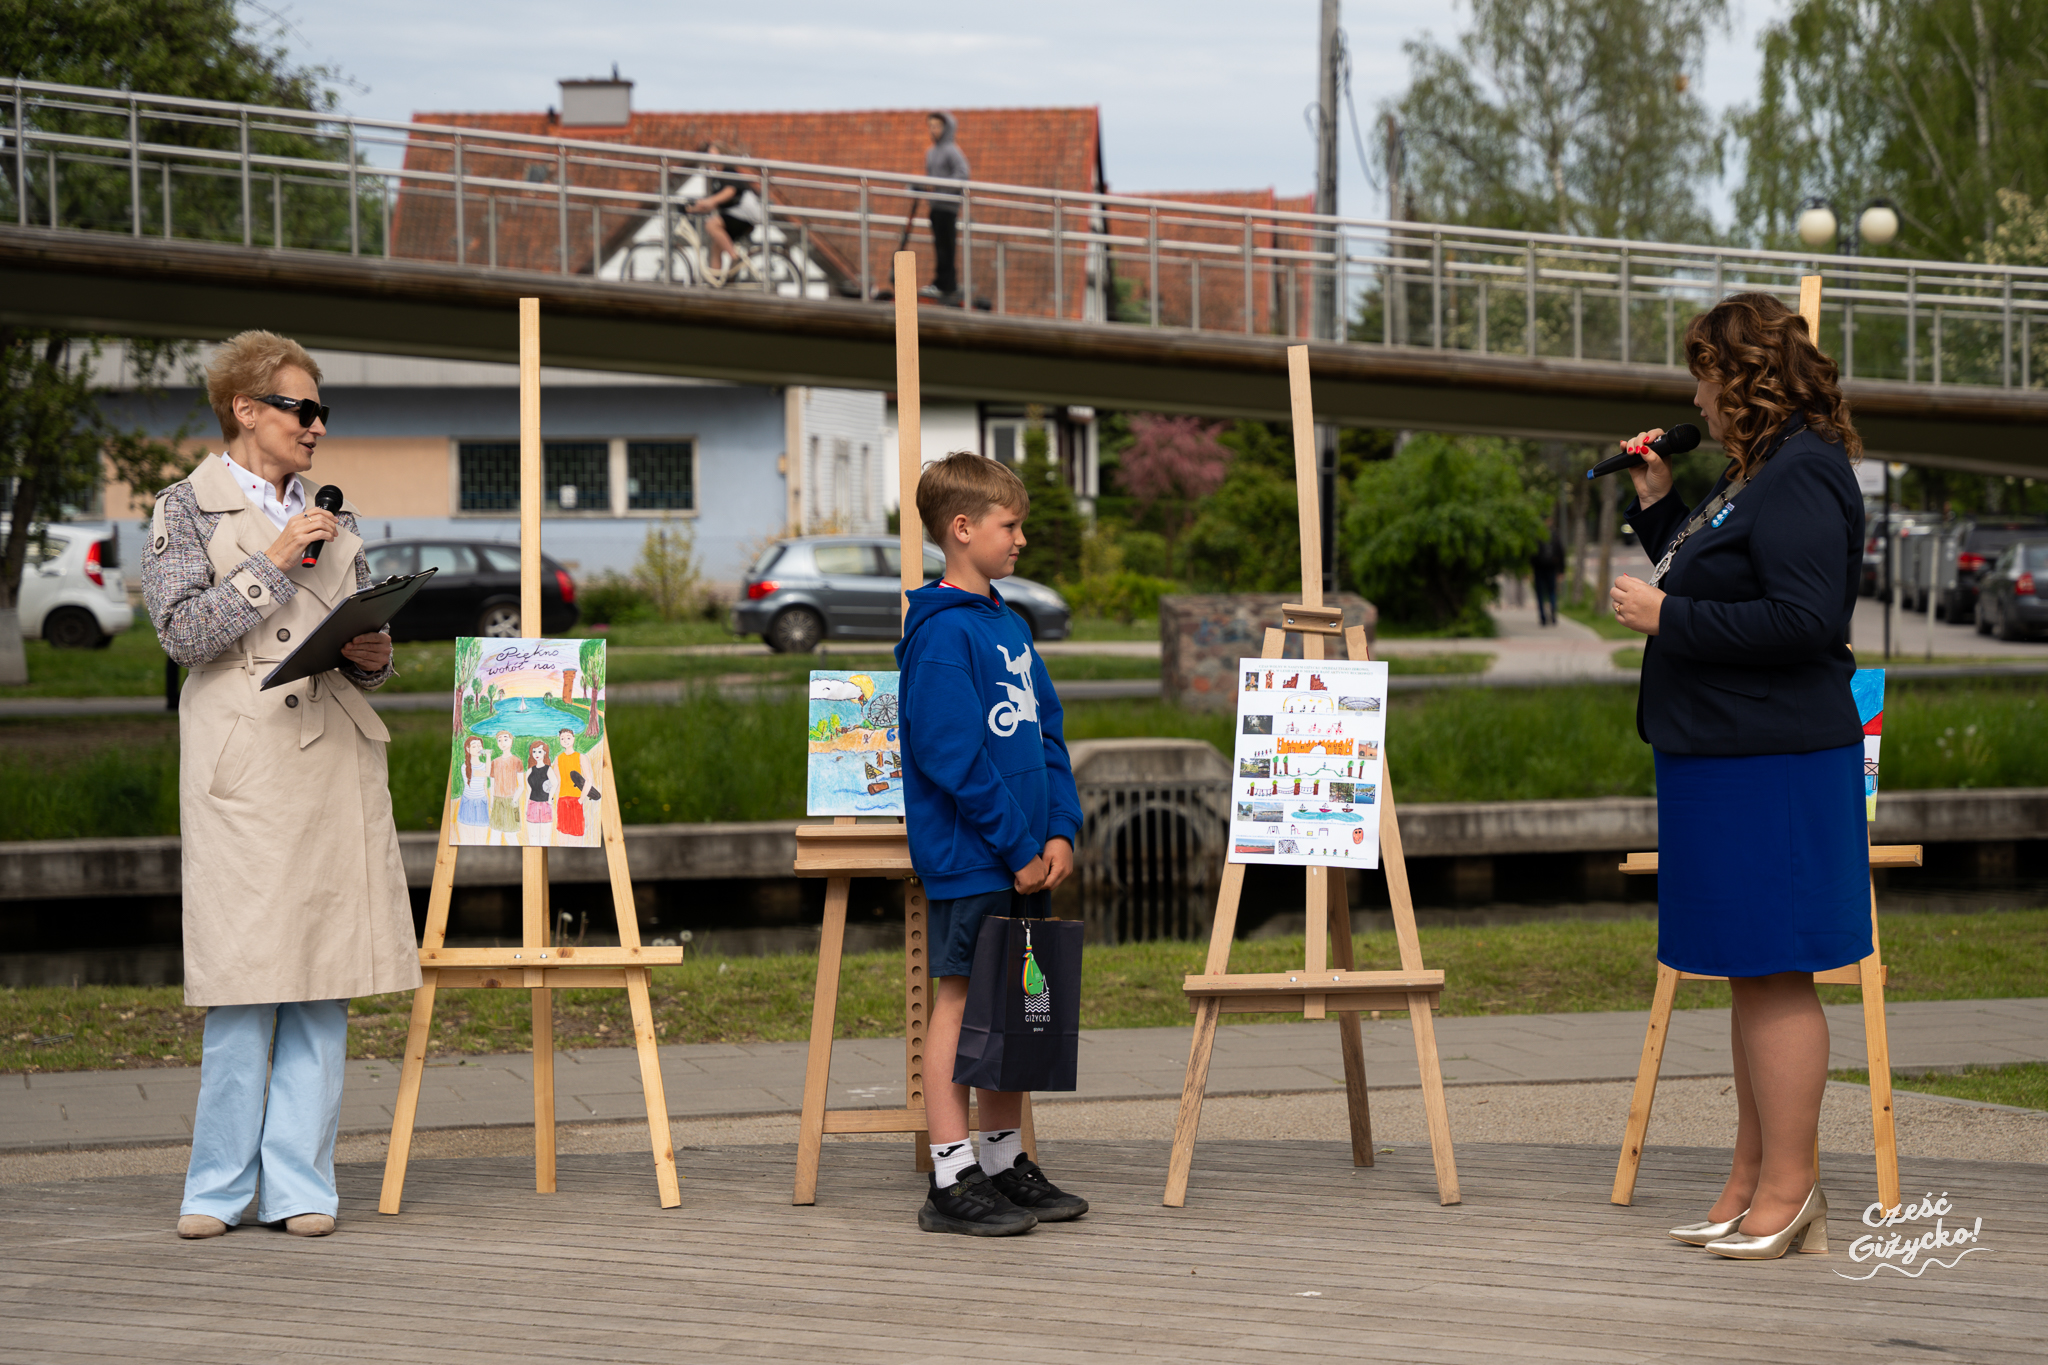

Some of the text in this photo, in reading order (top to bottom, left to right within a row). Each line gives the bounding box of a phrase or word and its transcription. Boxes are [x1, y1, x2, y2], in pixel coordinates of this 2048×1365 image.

[496, 644, 560, 664] Piękno
[486, 660, 556, 676] wokół nas
[1024, 1013, 1051, 1023] GIŻYCKO
